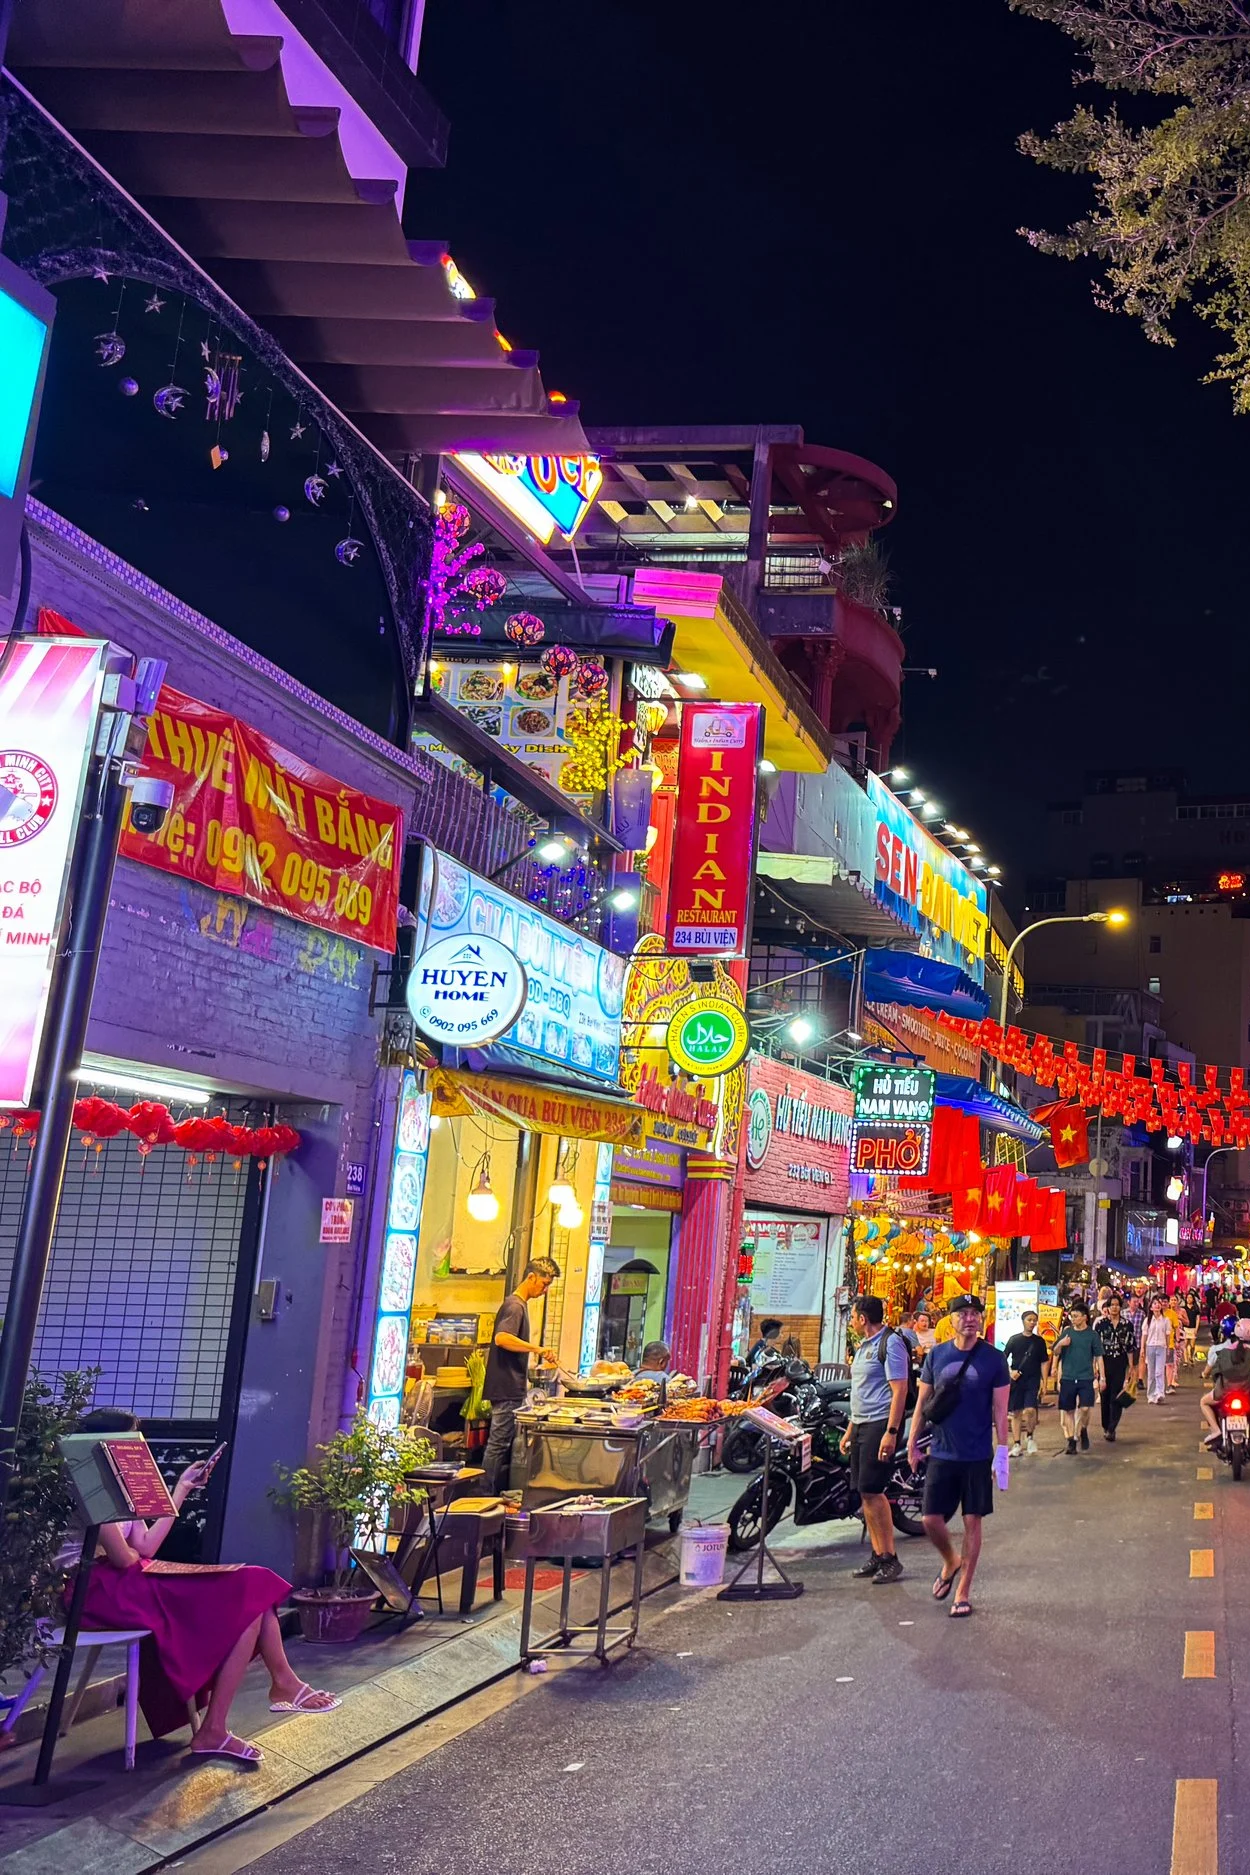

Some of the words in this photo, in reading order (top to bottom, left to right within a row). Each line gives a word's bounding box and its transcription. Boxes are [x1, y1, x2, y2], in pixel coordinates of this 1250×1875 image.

[146, 710, 235, 795] THUÊ
[4, 754, 38, 771] MINH
[34, 763, 54, 790] CITY
[17, 815, 45, 841] CLUB
[692, 752, 732, 909] INDIAN
[876, 821, 918, 905] SEN
[19, 879, 42, 900] BỘ
[281, 852, 332, 907] 095
[335, 875, 372, 926] 669
[2, 903, 25, 919] ĐÁ
[677, 910, 737, 924] RESTAURANT
[6, 932, 51, 946] MINH
[675, 930, 693, 944] 234
[694, 927, 715, 945] BÙI
[716, 929, 736, 947] VIỆN
[421, 969, 508, 988] HUYEN
[434, 990, 490, 1002] HOME
[549, 986, 571, 1019] BBQ
[429, 1016, 454, 1032] 0902
[457, 1021, 478, 1032] 095
[481, 1009, 499, 1026] 669
[698, 1001, 731, 1013] INDIAN
[731, 1011, 745, 1043] CURRY
[686, 1022, 730, 1045] حلال
[901, 1013, 931, 1042] SMOOTHIE
[934, 1031, 951, 1052] JUICE
[689, 1045, 724, 1053] HALAL
[873, 1073, 891, 1095] HỦ
[894, 1074, 919, 1096] TIẾU
[507, 1093, 538, 1121] CUA
[542, 1096, 567, 1125] BÙI
[859, 1099, 890, 1115] NAM
[892, 1100, 929, 1116] VANG
[857, 1129, 922, 1169] PHỞ
[347, 1165, 363, 1182] 238
